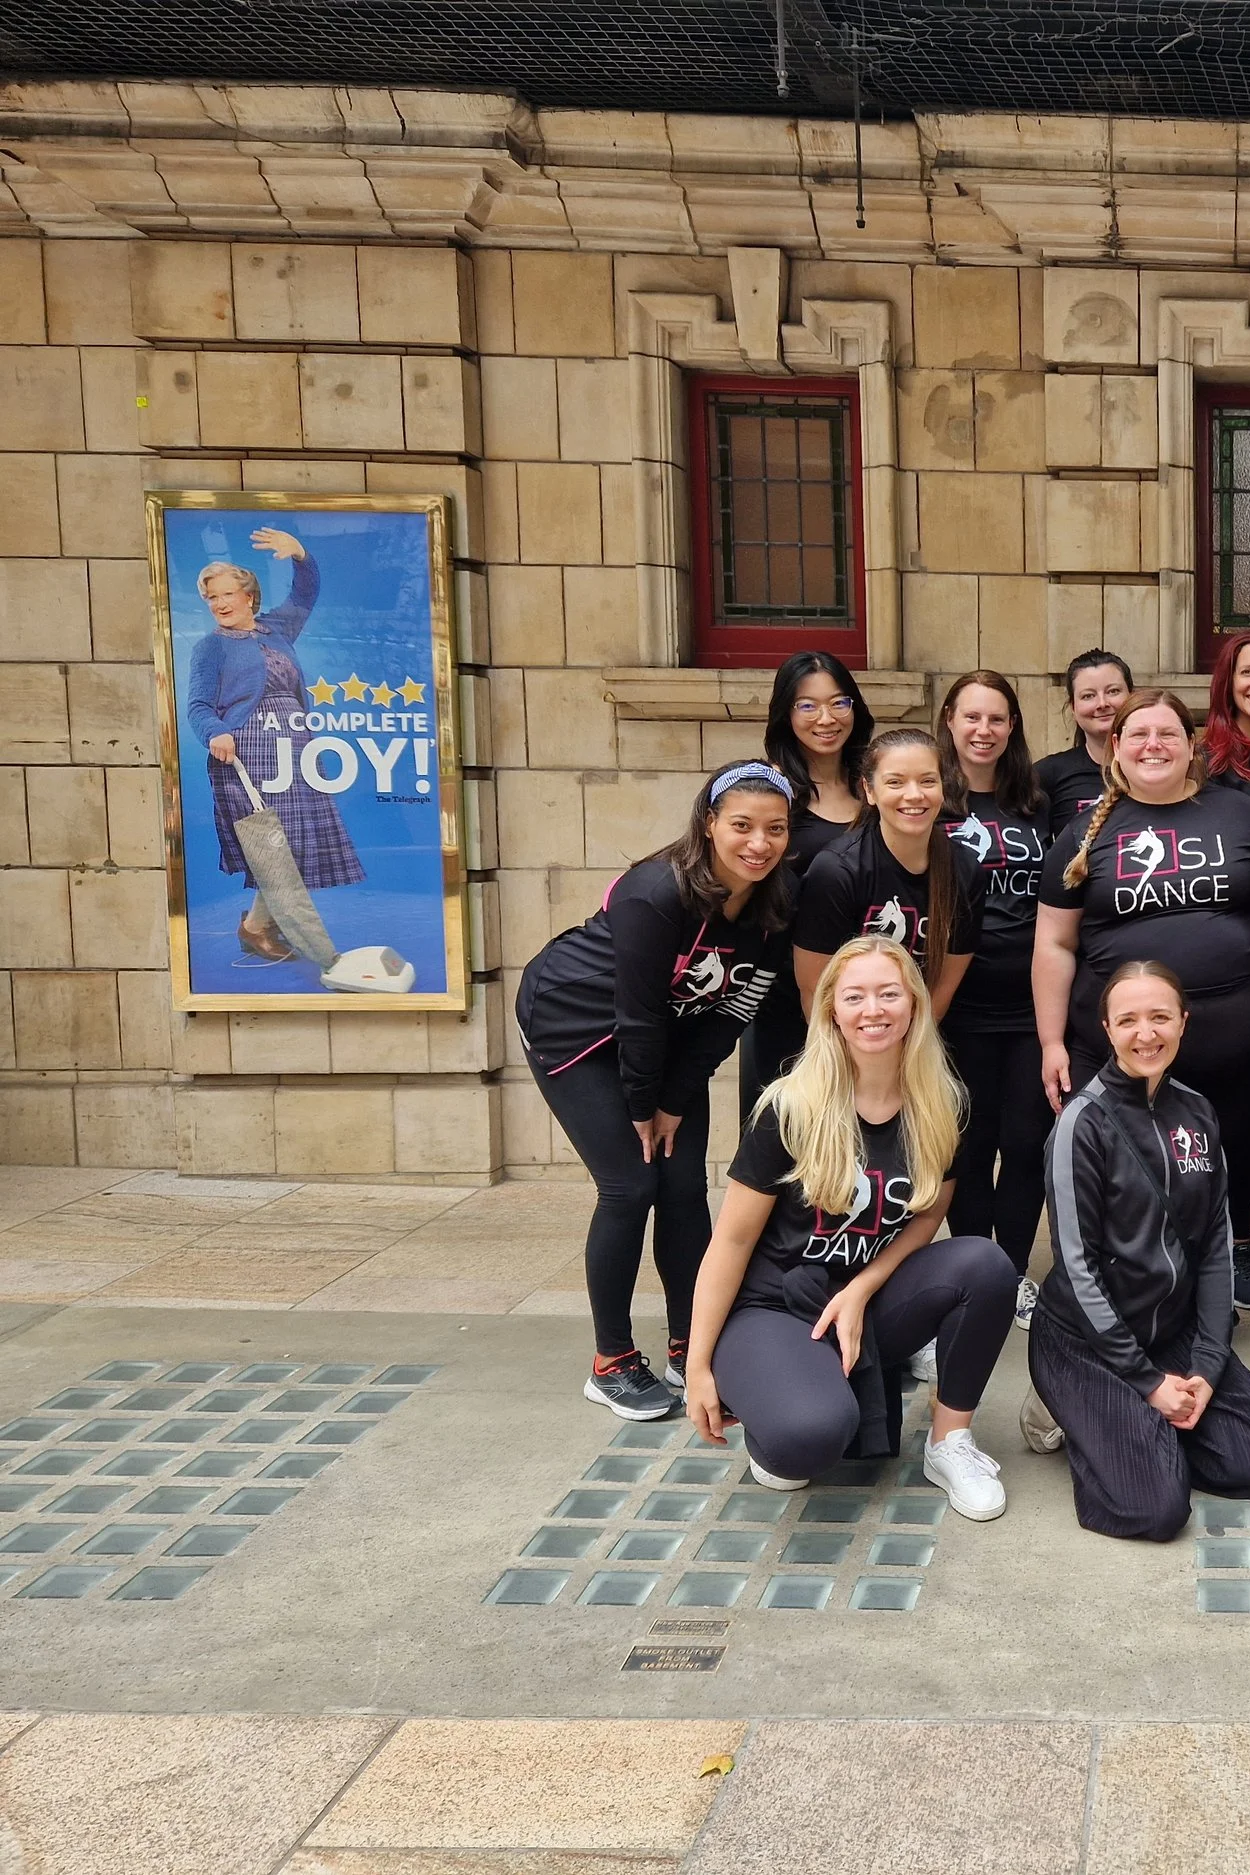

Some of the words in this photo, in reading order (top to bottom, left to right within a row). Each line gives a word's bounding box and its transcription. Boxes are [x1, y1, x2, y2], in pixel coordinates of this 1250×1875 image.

[288, 711, 428, 733] COMPLETE
[392, 796, 431, 804] Telegraph
[1001, 827, 1044, 862] SJ
[1177, 834, 1225, 870] SJ
[1114, 874, 1230, 914] DANCE
[1193, 1132, 1209, 1154] SJ
[1177, 1156, 1213, 1174] DANCE
[635, 1648, 675, 1656] SMOKE
[677, 1648, 721, 1656] OUTLET
